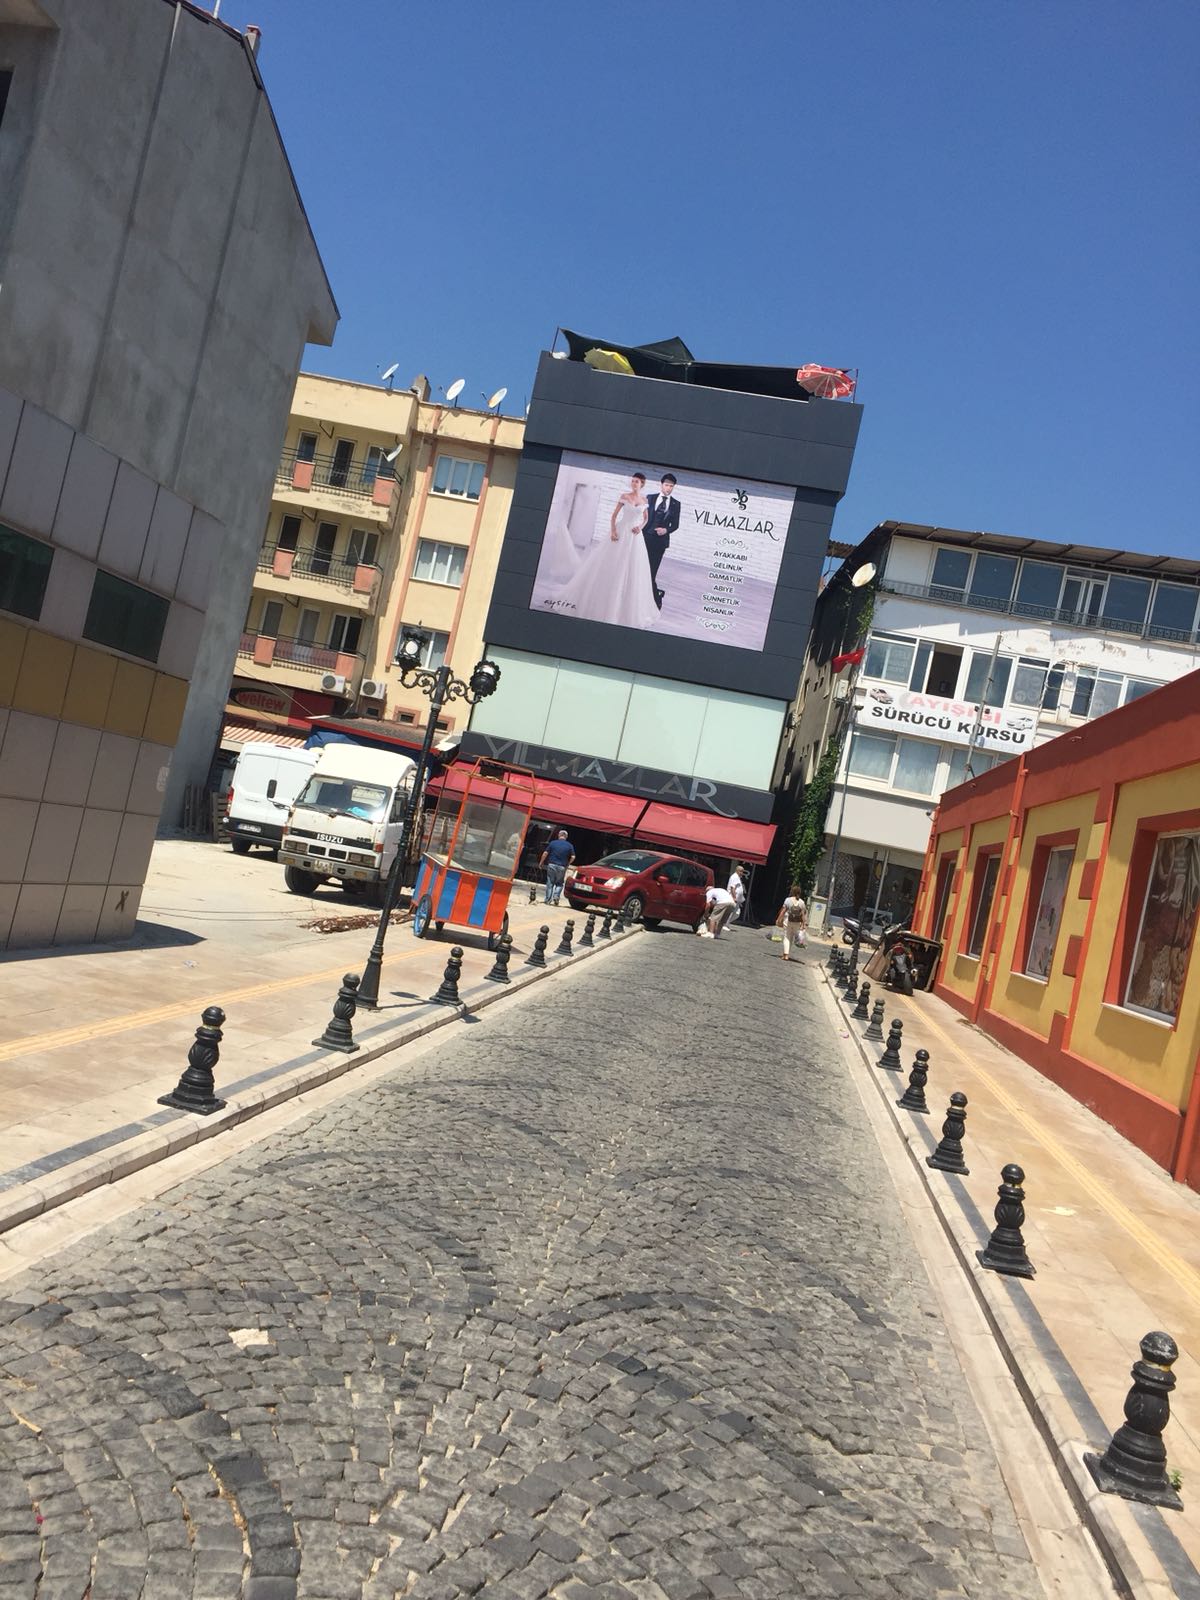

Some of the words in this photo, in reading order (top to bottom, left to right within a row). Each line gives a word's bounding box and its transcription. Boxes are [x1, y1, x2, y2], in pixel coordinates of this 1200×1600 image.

[694, 509, 780, 541] YILMAZLAR
[713, 551, 748, 561] AYAKKABI
[871, 706, 951, 730] SÜRÜCÜ
[957, 722, 1026, 744] KURSU
[483, 735, 739, 819] YILMAZLAR
[317, 832, 344, 844] ISUZU
